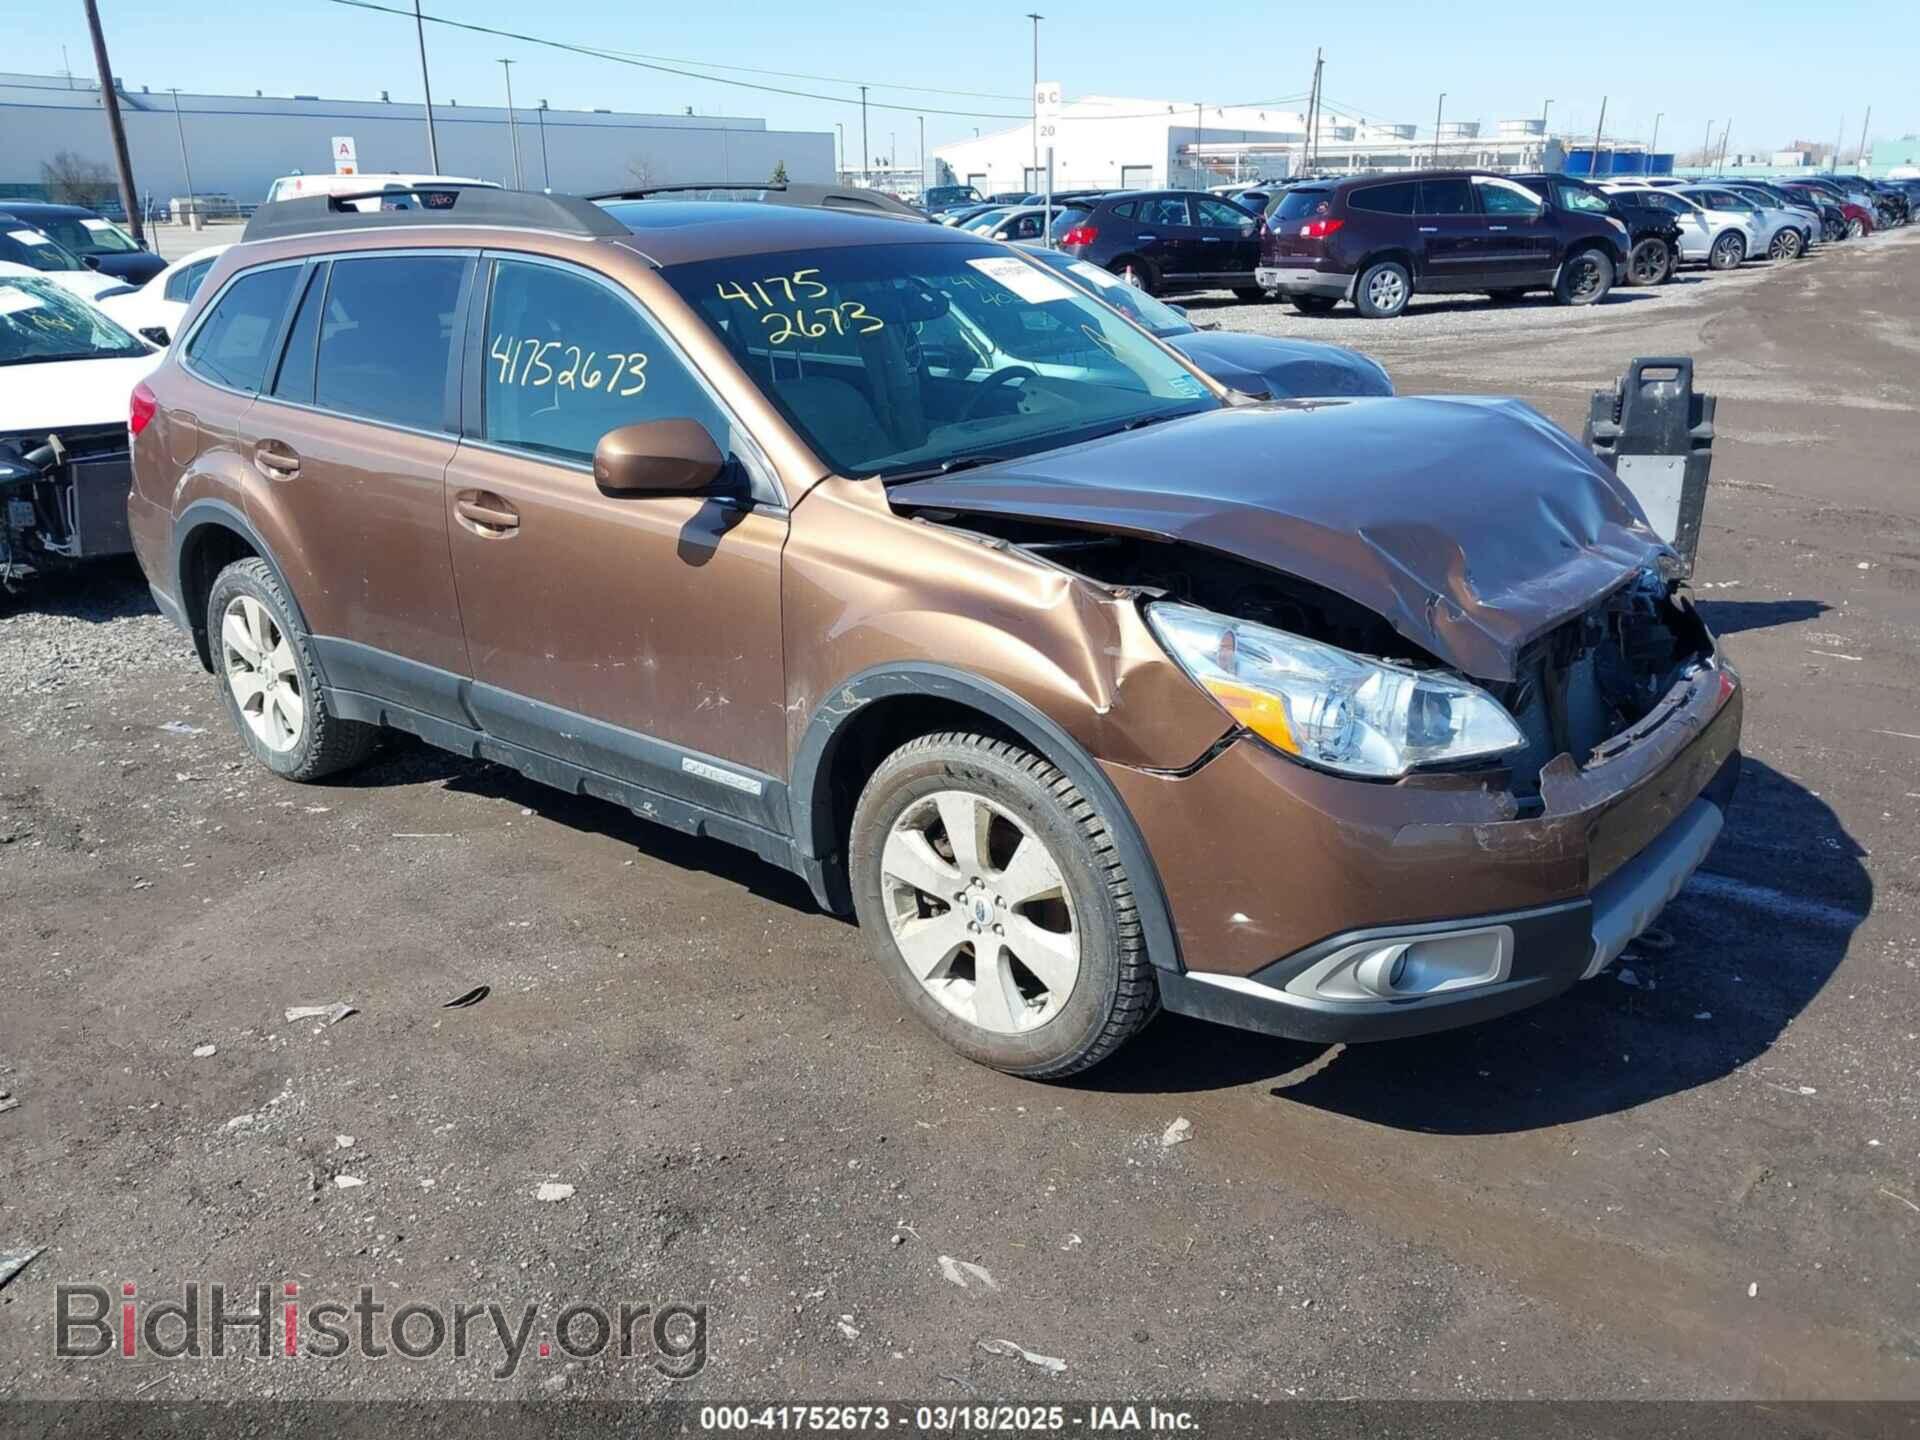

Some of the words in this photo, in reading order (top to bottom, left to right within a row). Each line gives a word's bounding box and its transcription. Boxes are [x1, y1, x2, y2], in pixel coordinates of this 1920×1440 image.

[1037, 92, 1046, 104] B
[1049, 91, 1057, 104] C
[1040, 125, 1055, 137] 20
[339, 143, 350, 155] A
[716, 268, 829, 311] 4175
[761, 301, 885, 345] 2673
[491, 333, 649, 396] 41752673
